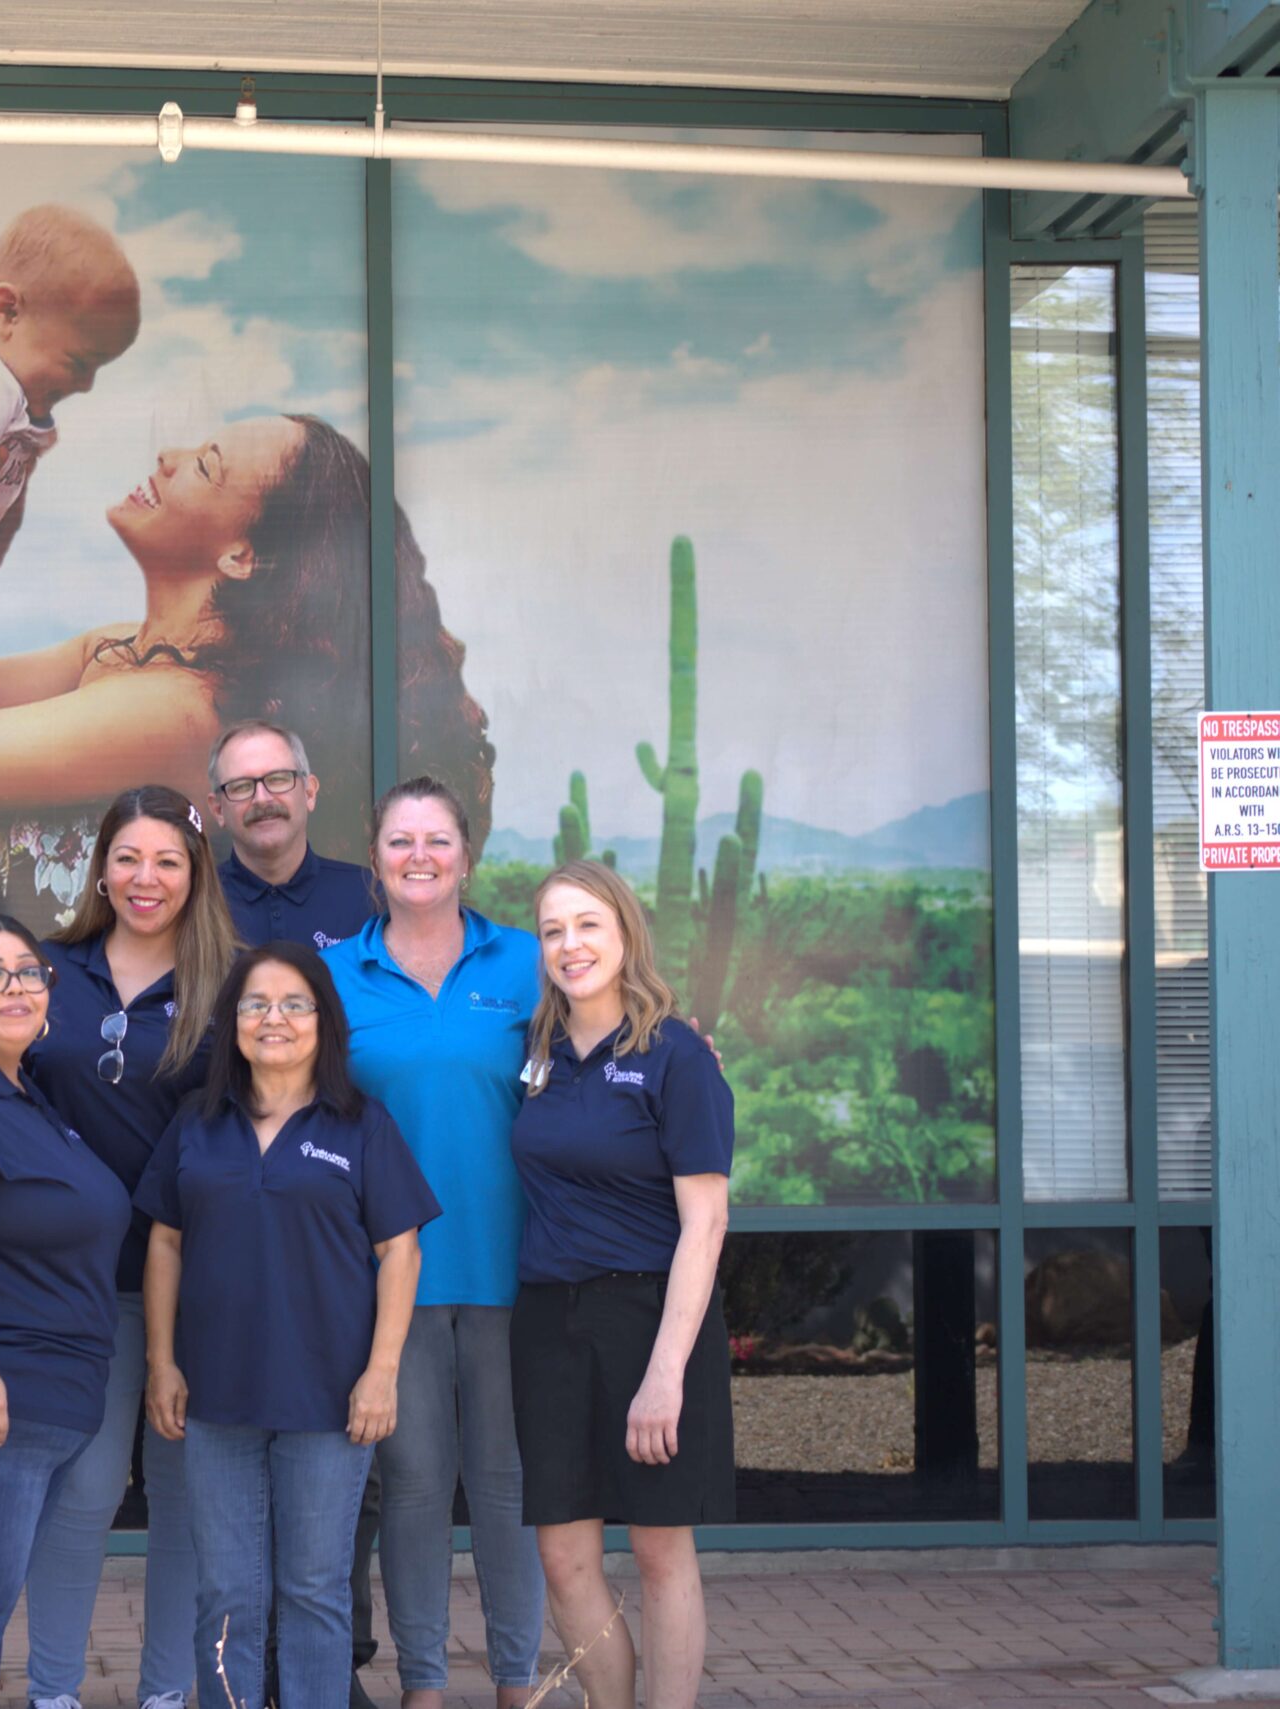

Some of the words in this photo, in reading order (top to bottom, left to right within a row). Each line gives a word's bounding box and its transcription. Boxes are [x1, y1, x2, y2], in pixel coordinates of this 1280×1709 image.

[1203, 720, 1219, 737] NO
[1210, 747, 1264, 760] VIOLATORS
[1211, 767, 1223, 779] BE
[1227, 766, 1280, 779] PROSECUT
[1211, 786, 1222, 798] IN
[1239, 804, 1264, 817] WITH
[1215, 823, 1244, 836] A.R.S.
[1203, 846, 1248, 864] PRIVATE
